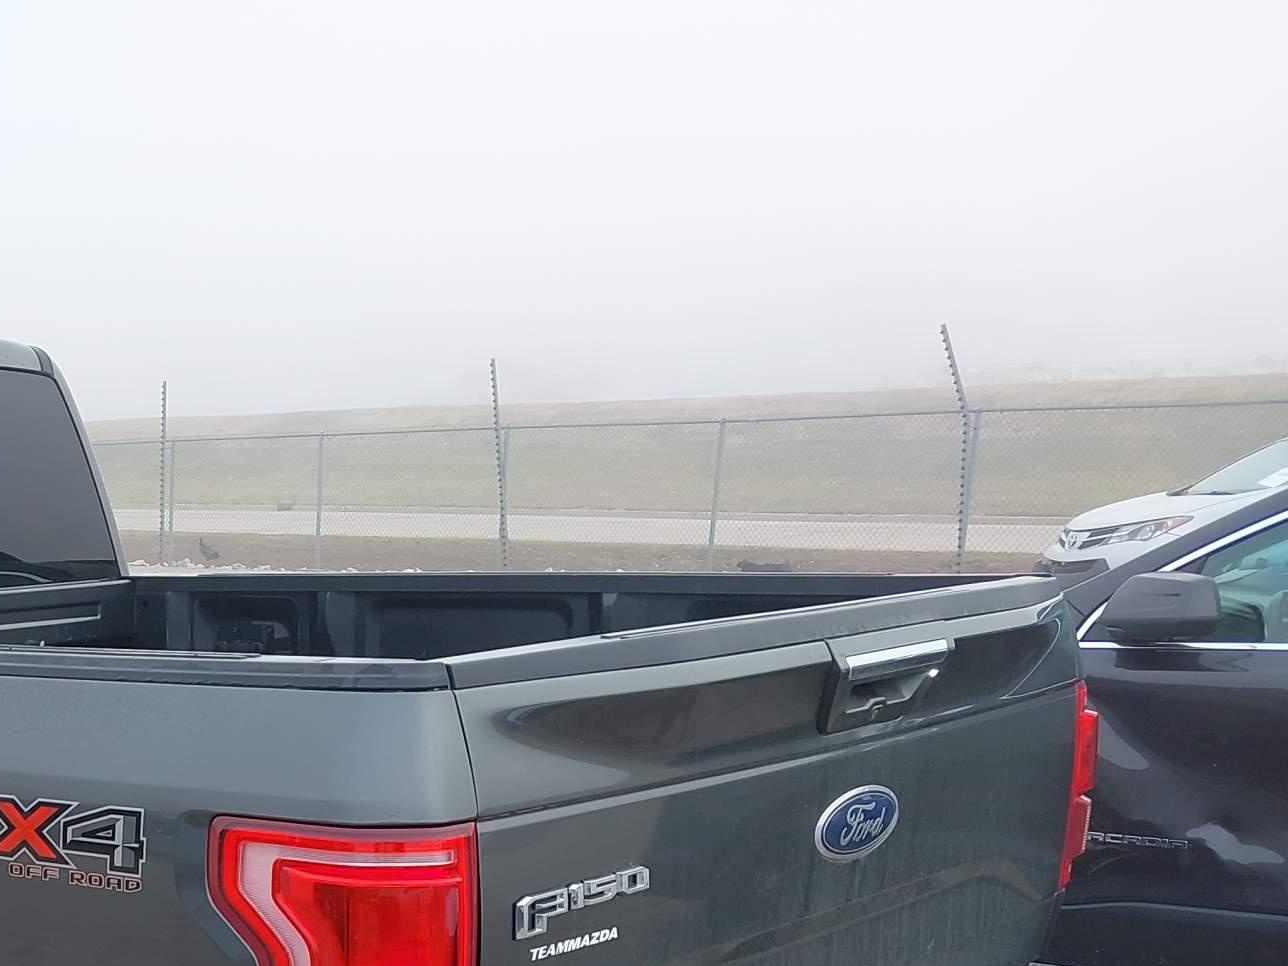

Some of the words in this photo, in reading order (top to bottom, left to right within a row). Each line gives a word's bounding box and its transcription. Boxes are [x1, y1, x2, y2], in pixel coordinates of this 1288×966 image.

[839, 801, 887, 846] Ford
[8, 862, 60, 881] OFF
[68, 870, 143, 893] ROAD
[530, 926, 619, 962] TEAMMAZDA
